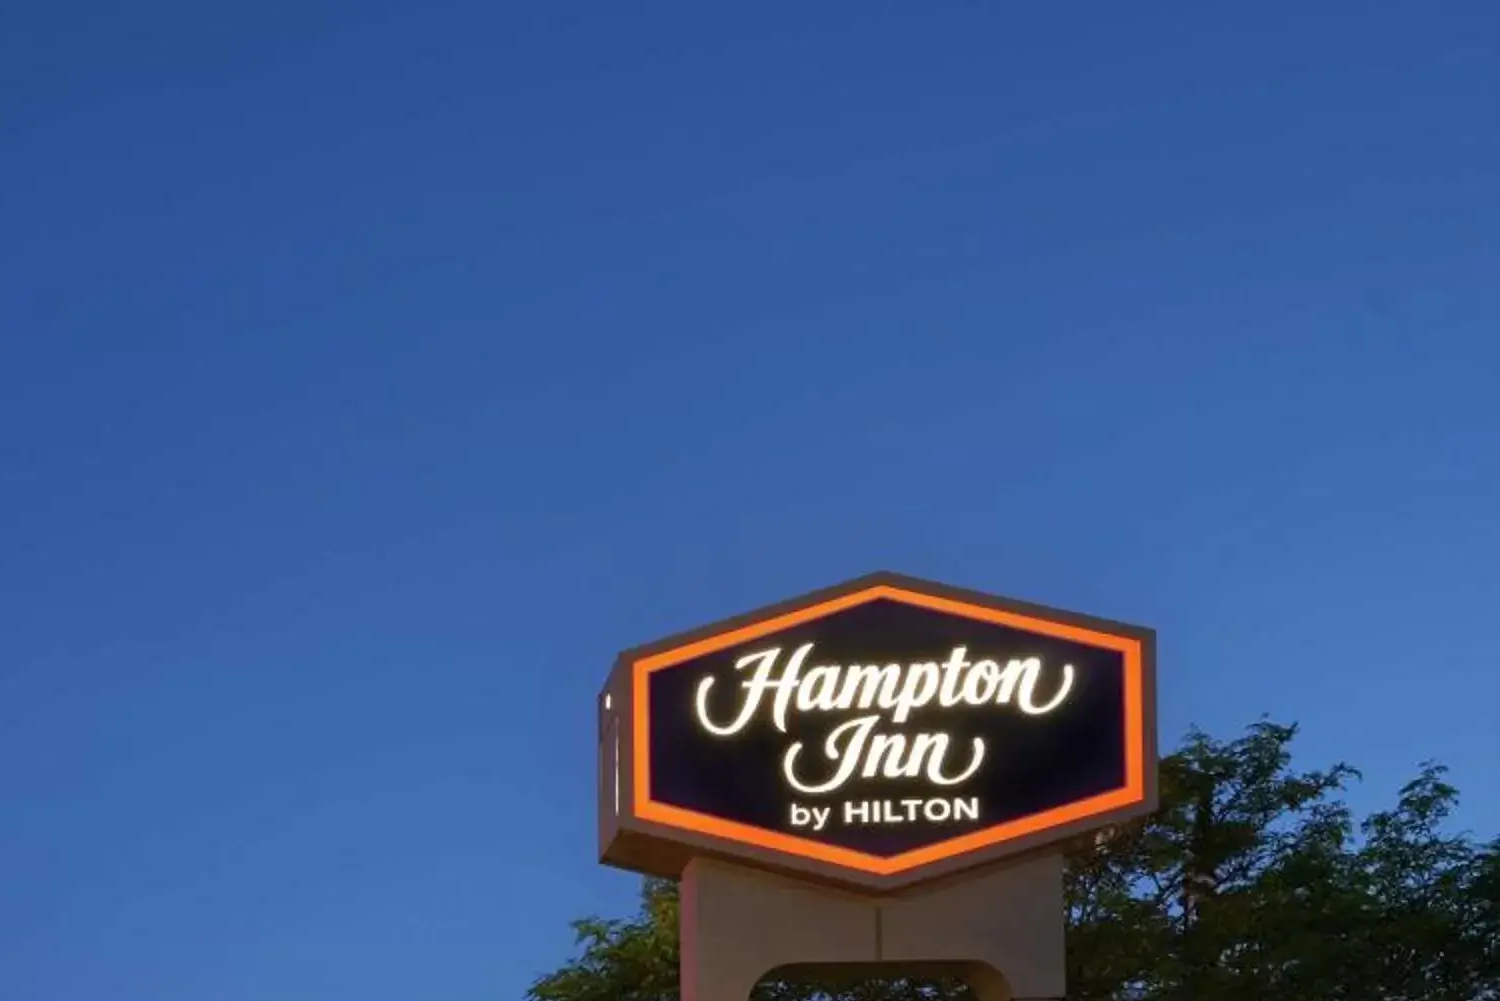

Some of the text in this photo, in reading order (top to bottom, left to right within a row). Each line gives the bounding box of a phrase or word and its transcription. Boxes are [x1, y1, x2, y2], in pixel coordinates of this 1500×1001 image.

[695, 642, 1075, 736] Hampton
[783, 714, 985, 793] Inn
[791, 797, 979, 831] by HILTON
